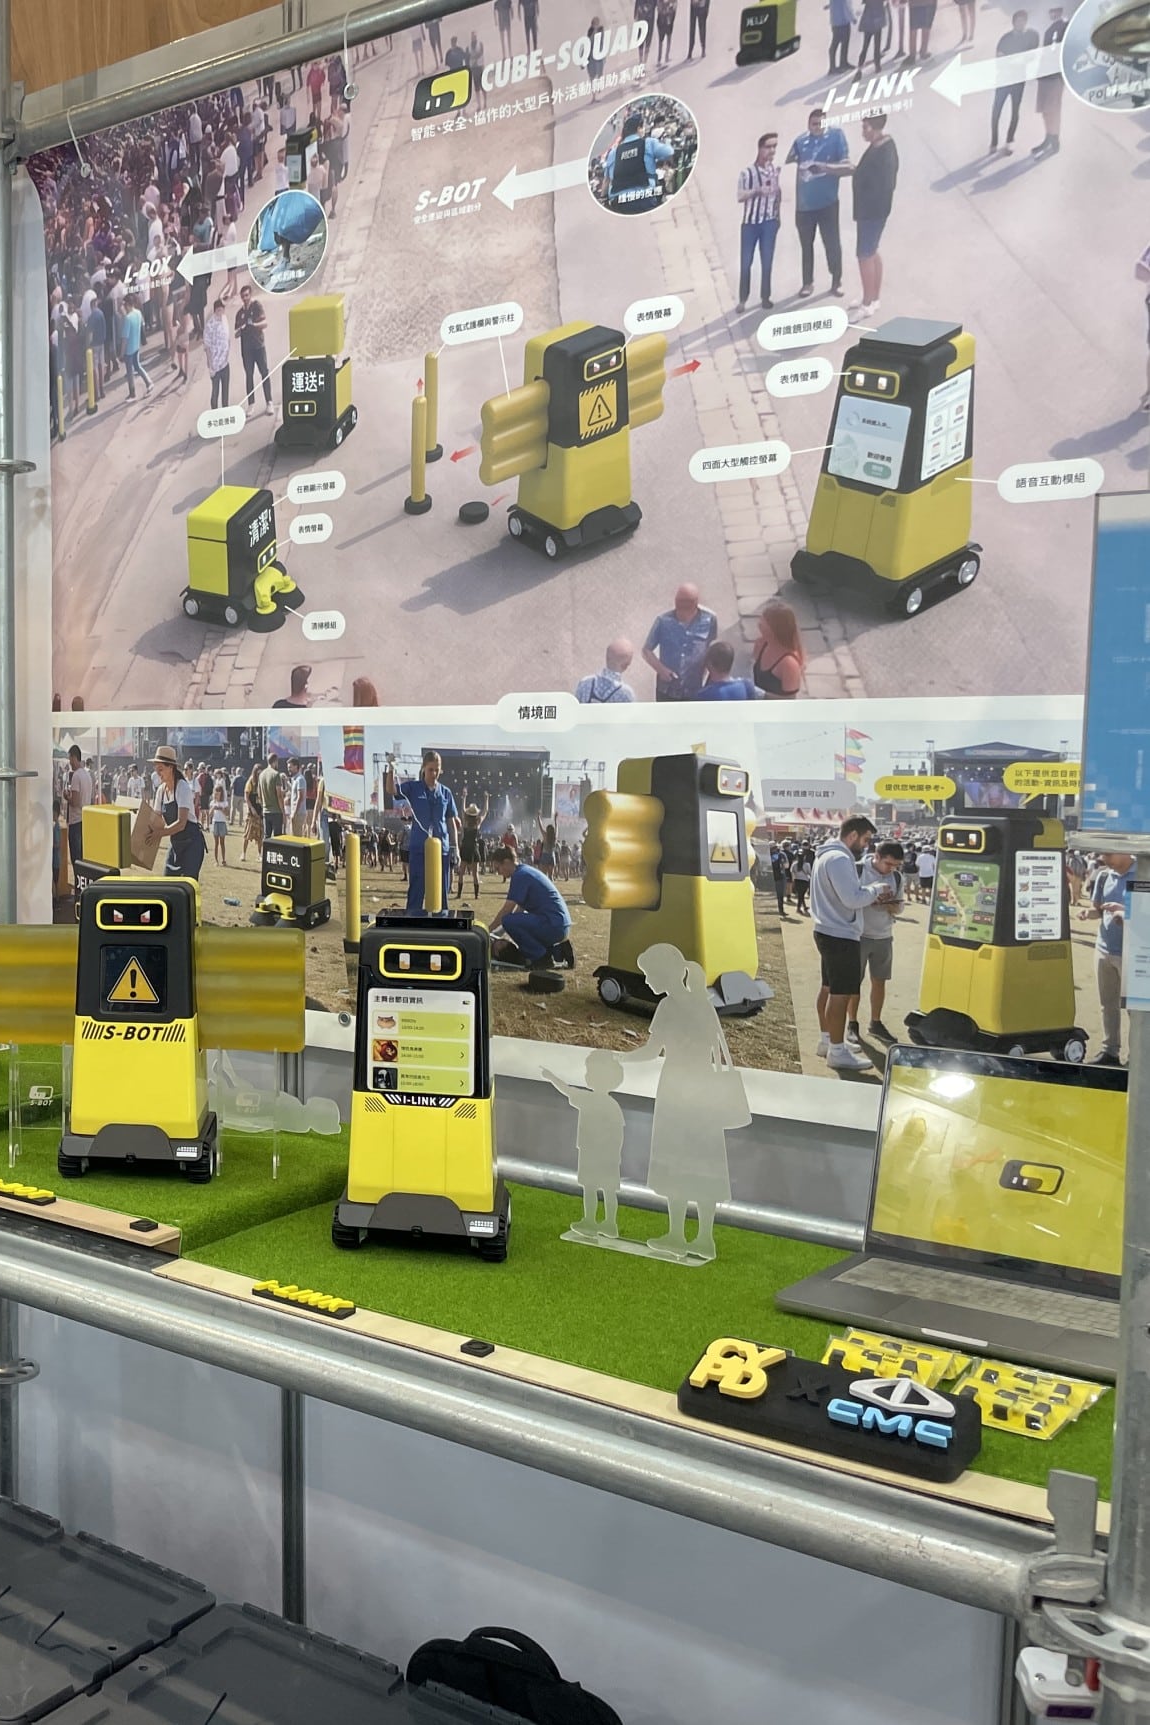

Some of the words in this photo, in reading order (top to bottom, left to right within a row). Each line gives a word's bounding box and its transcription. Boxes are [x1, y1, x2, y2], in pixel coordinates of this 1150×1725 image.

[481, 20, 649, 92] CUBE-SQUAD
[822, 67, 923, 113] I-LINK
[415, 177, 487, 211] S-BOT
[124, 254, 173, 284] L-BOX
[636, 307, 672, 323] 表情螢幕
[772, 318, 833, 338] 辨識鏡頭模組
[779, 370, 820, 385] 表情螢幕
[702, 453, 778, 471] 四面大型觸控螢幕
[1015, 472, 1086, 489] 語音互動模組
[517, 704, 557, 721] 情境圖
[103, 1025, 164, 1042] S-BOT
[29, 1099, 54, 1107] S-BOT
[402, 1095, 437, 1106] I-LINK
[827, 1398, 953, 1449] CMC
